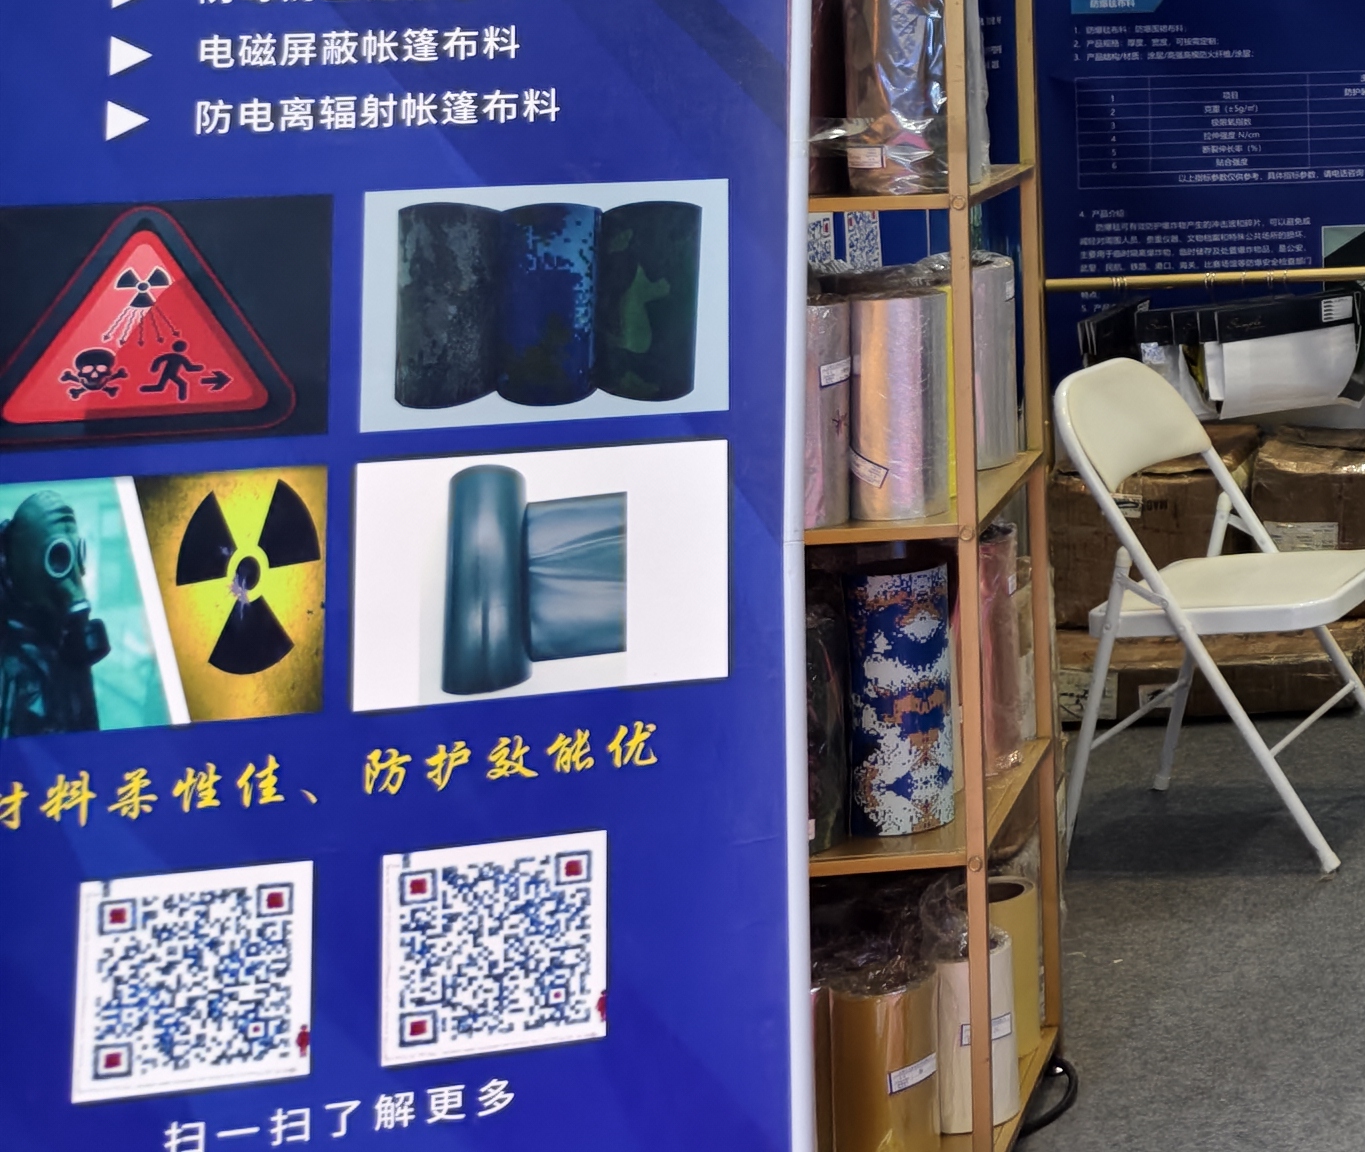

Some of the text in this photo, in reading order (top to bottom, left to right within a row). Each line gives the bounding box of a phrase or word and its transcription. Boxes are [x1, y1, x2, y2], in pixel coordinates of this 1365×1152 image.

[198, 24, 521, 71] 电磁屏蔽帐篷布料
[195, 88, 561, 135] 防电离辐射帐篷布料
[163, 1077, 517, 1152] 扫一扫了解更多
